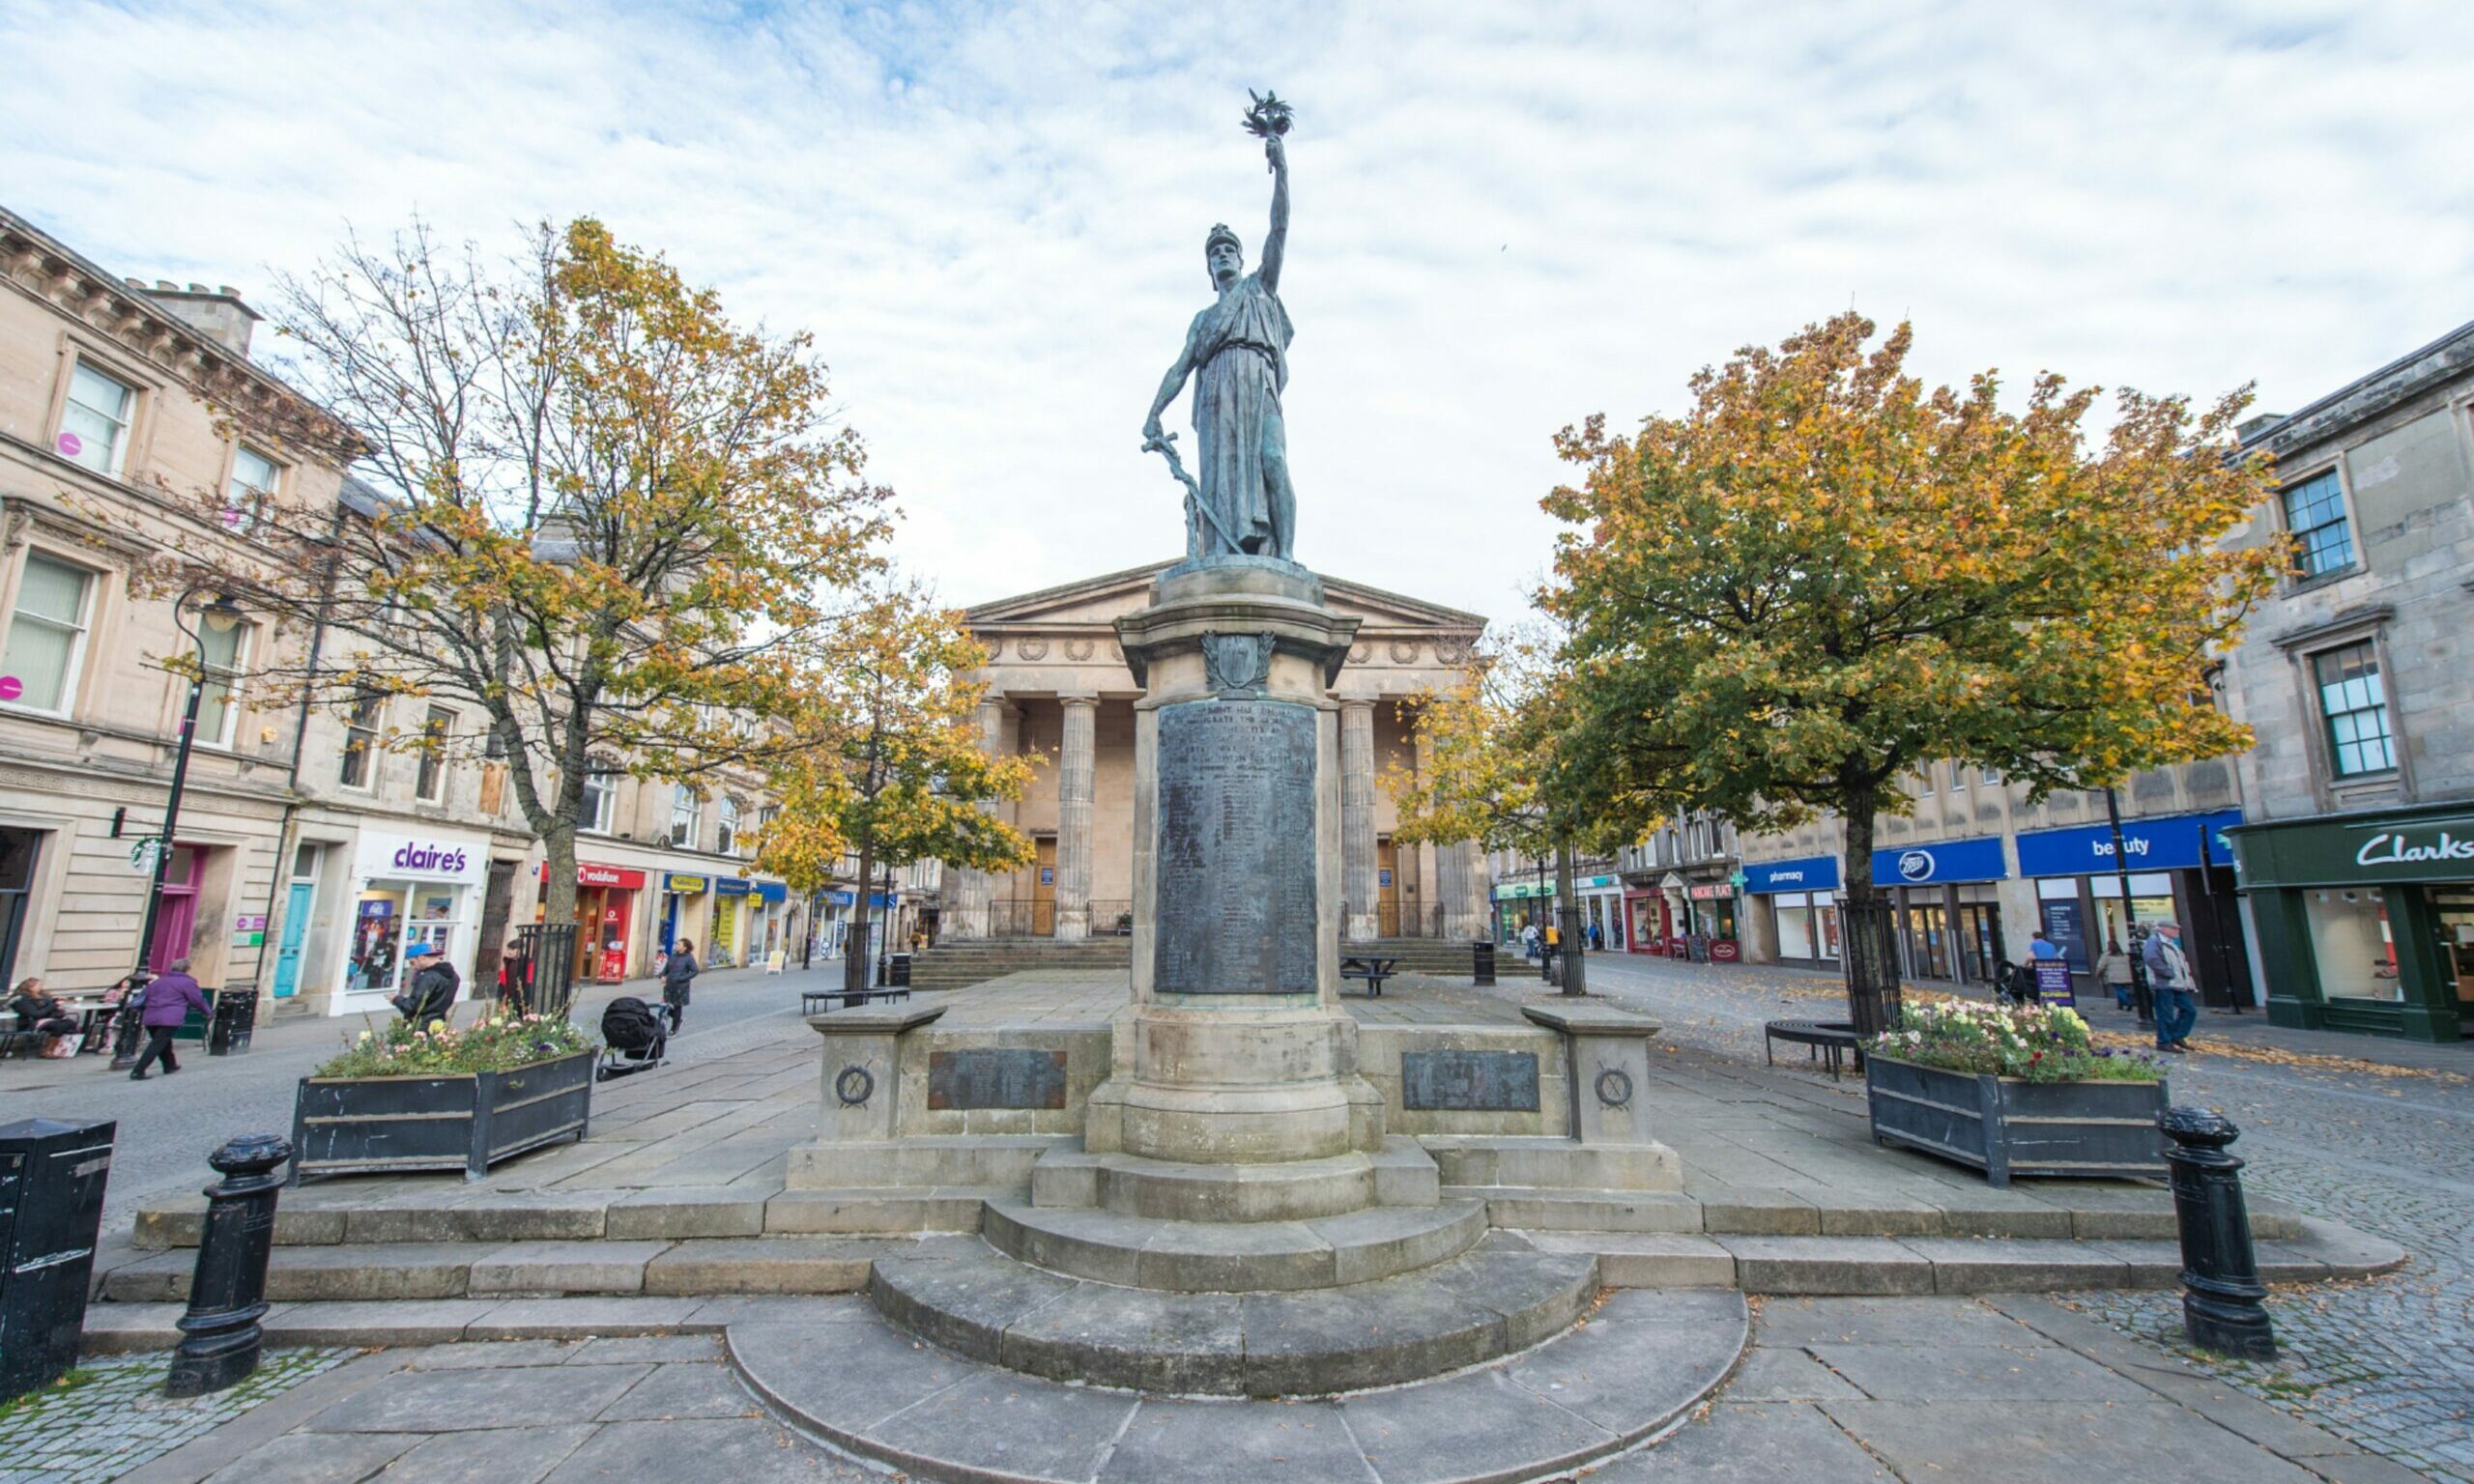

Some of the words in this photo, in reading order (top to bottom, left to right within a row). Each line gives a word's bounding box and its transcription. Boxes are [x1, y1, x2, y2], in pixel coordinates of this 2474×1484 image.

[2092, 837, 2149, 856] beuty
[2357, 832, 2474, 866] Clarks
[394, 842, 466, 871] claire's
[587, 870, 618, 883] vodafone
[1769, 870, 1803, 883] pharmacy
